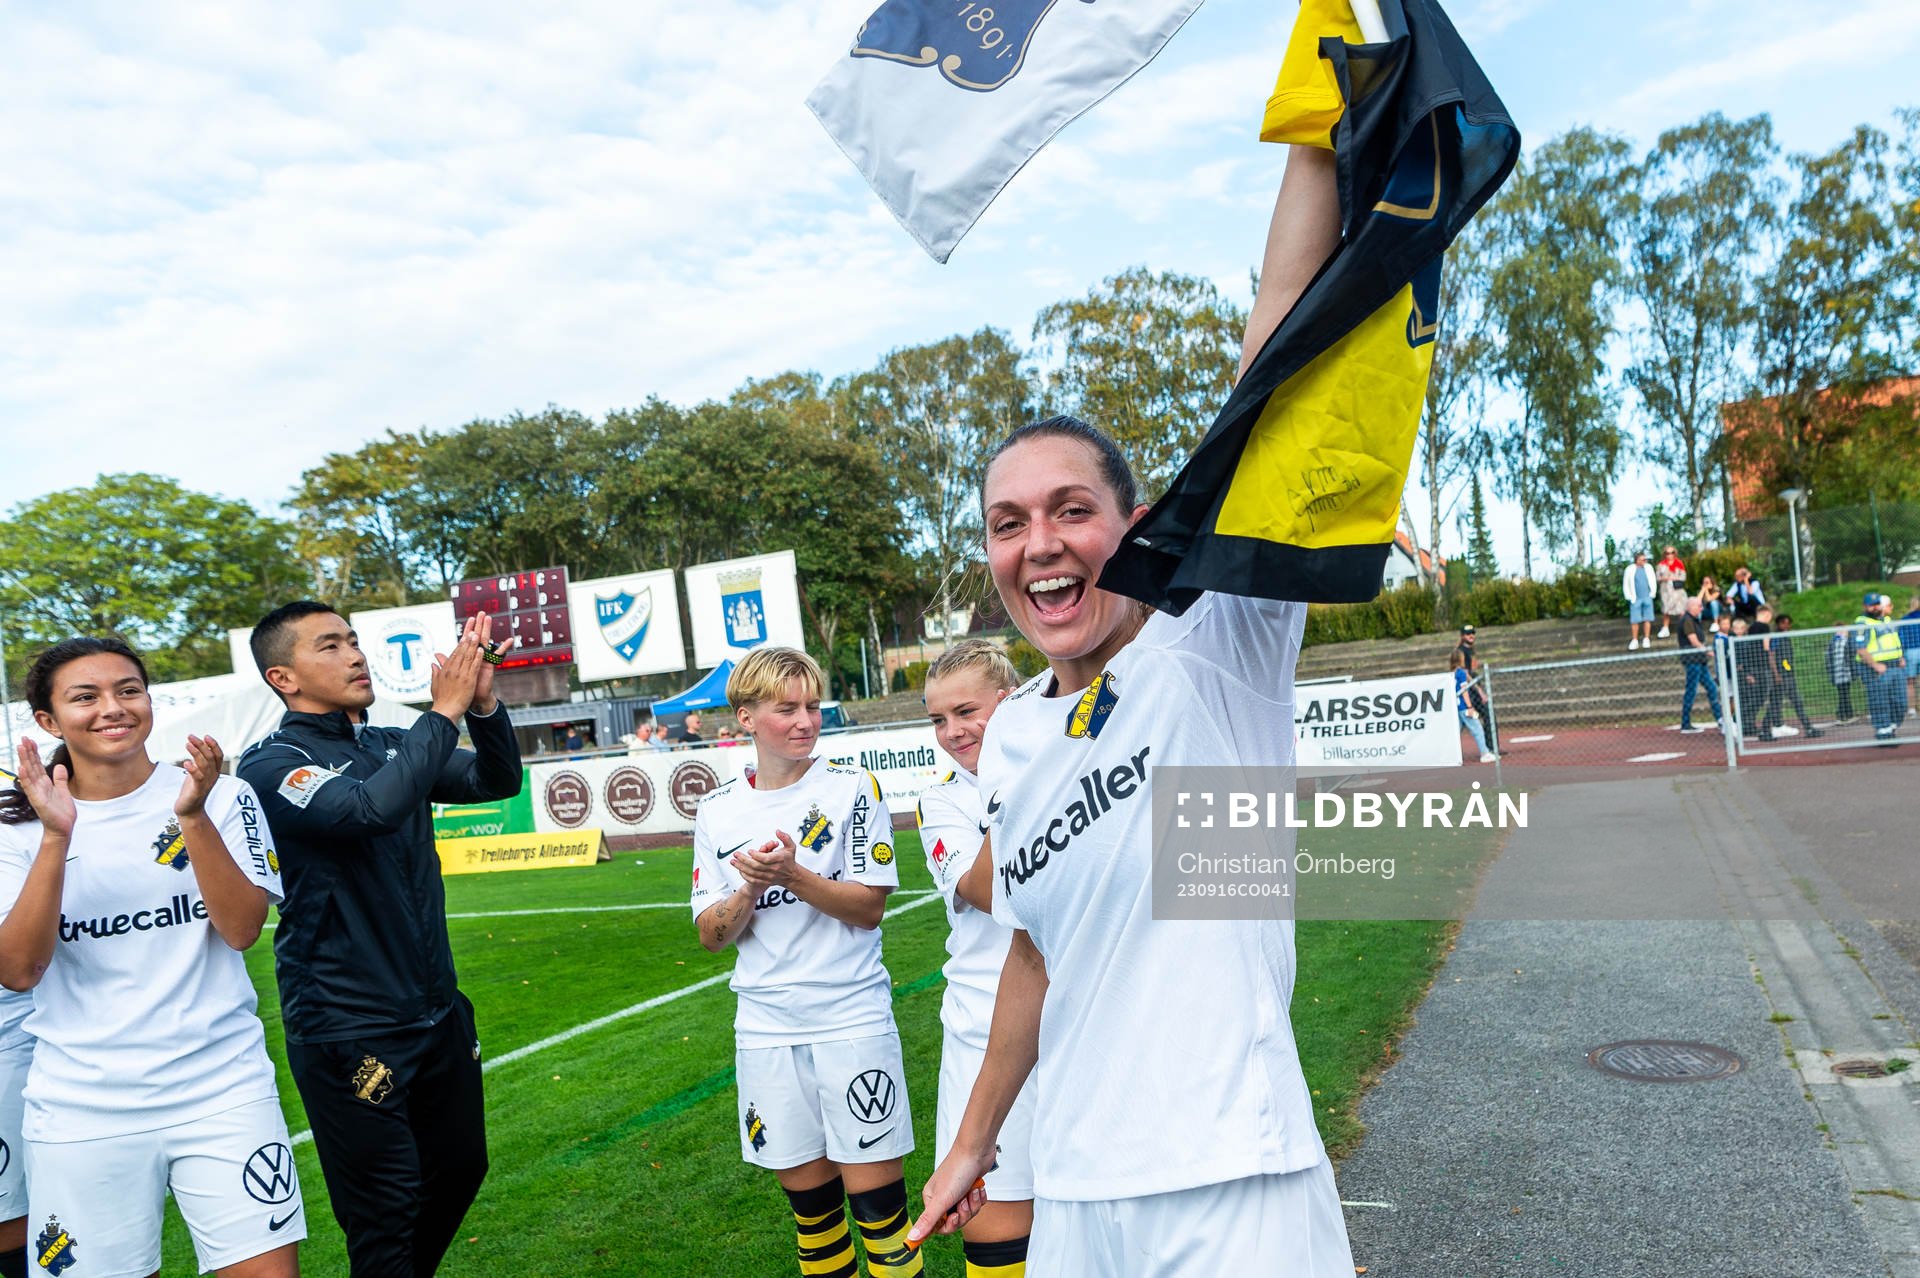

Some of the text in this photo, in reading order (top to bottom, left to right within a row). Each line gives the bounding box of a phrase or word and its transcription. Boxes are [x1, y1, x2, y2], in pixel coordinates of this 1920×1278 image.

[600, 600, 624, 617] IFK
[1311, 717, 1426, 738] TRELLEBORG
[861, 745, 936, 771] Allehanda
[1322, 743, 1407, 761] billarsson.se
[236, 793, 268, 877] stadium
[470, 822, 504, 835] way
[852, 794, 870, 874] stadium
[481, 842, 589, 863] Trelleborgs Allehanda
[58, 894, 208, 943] truecalle
